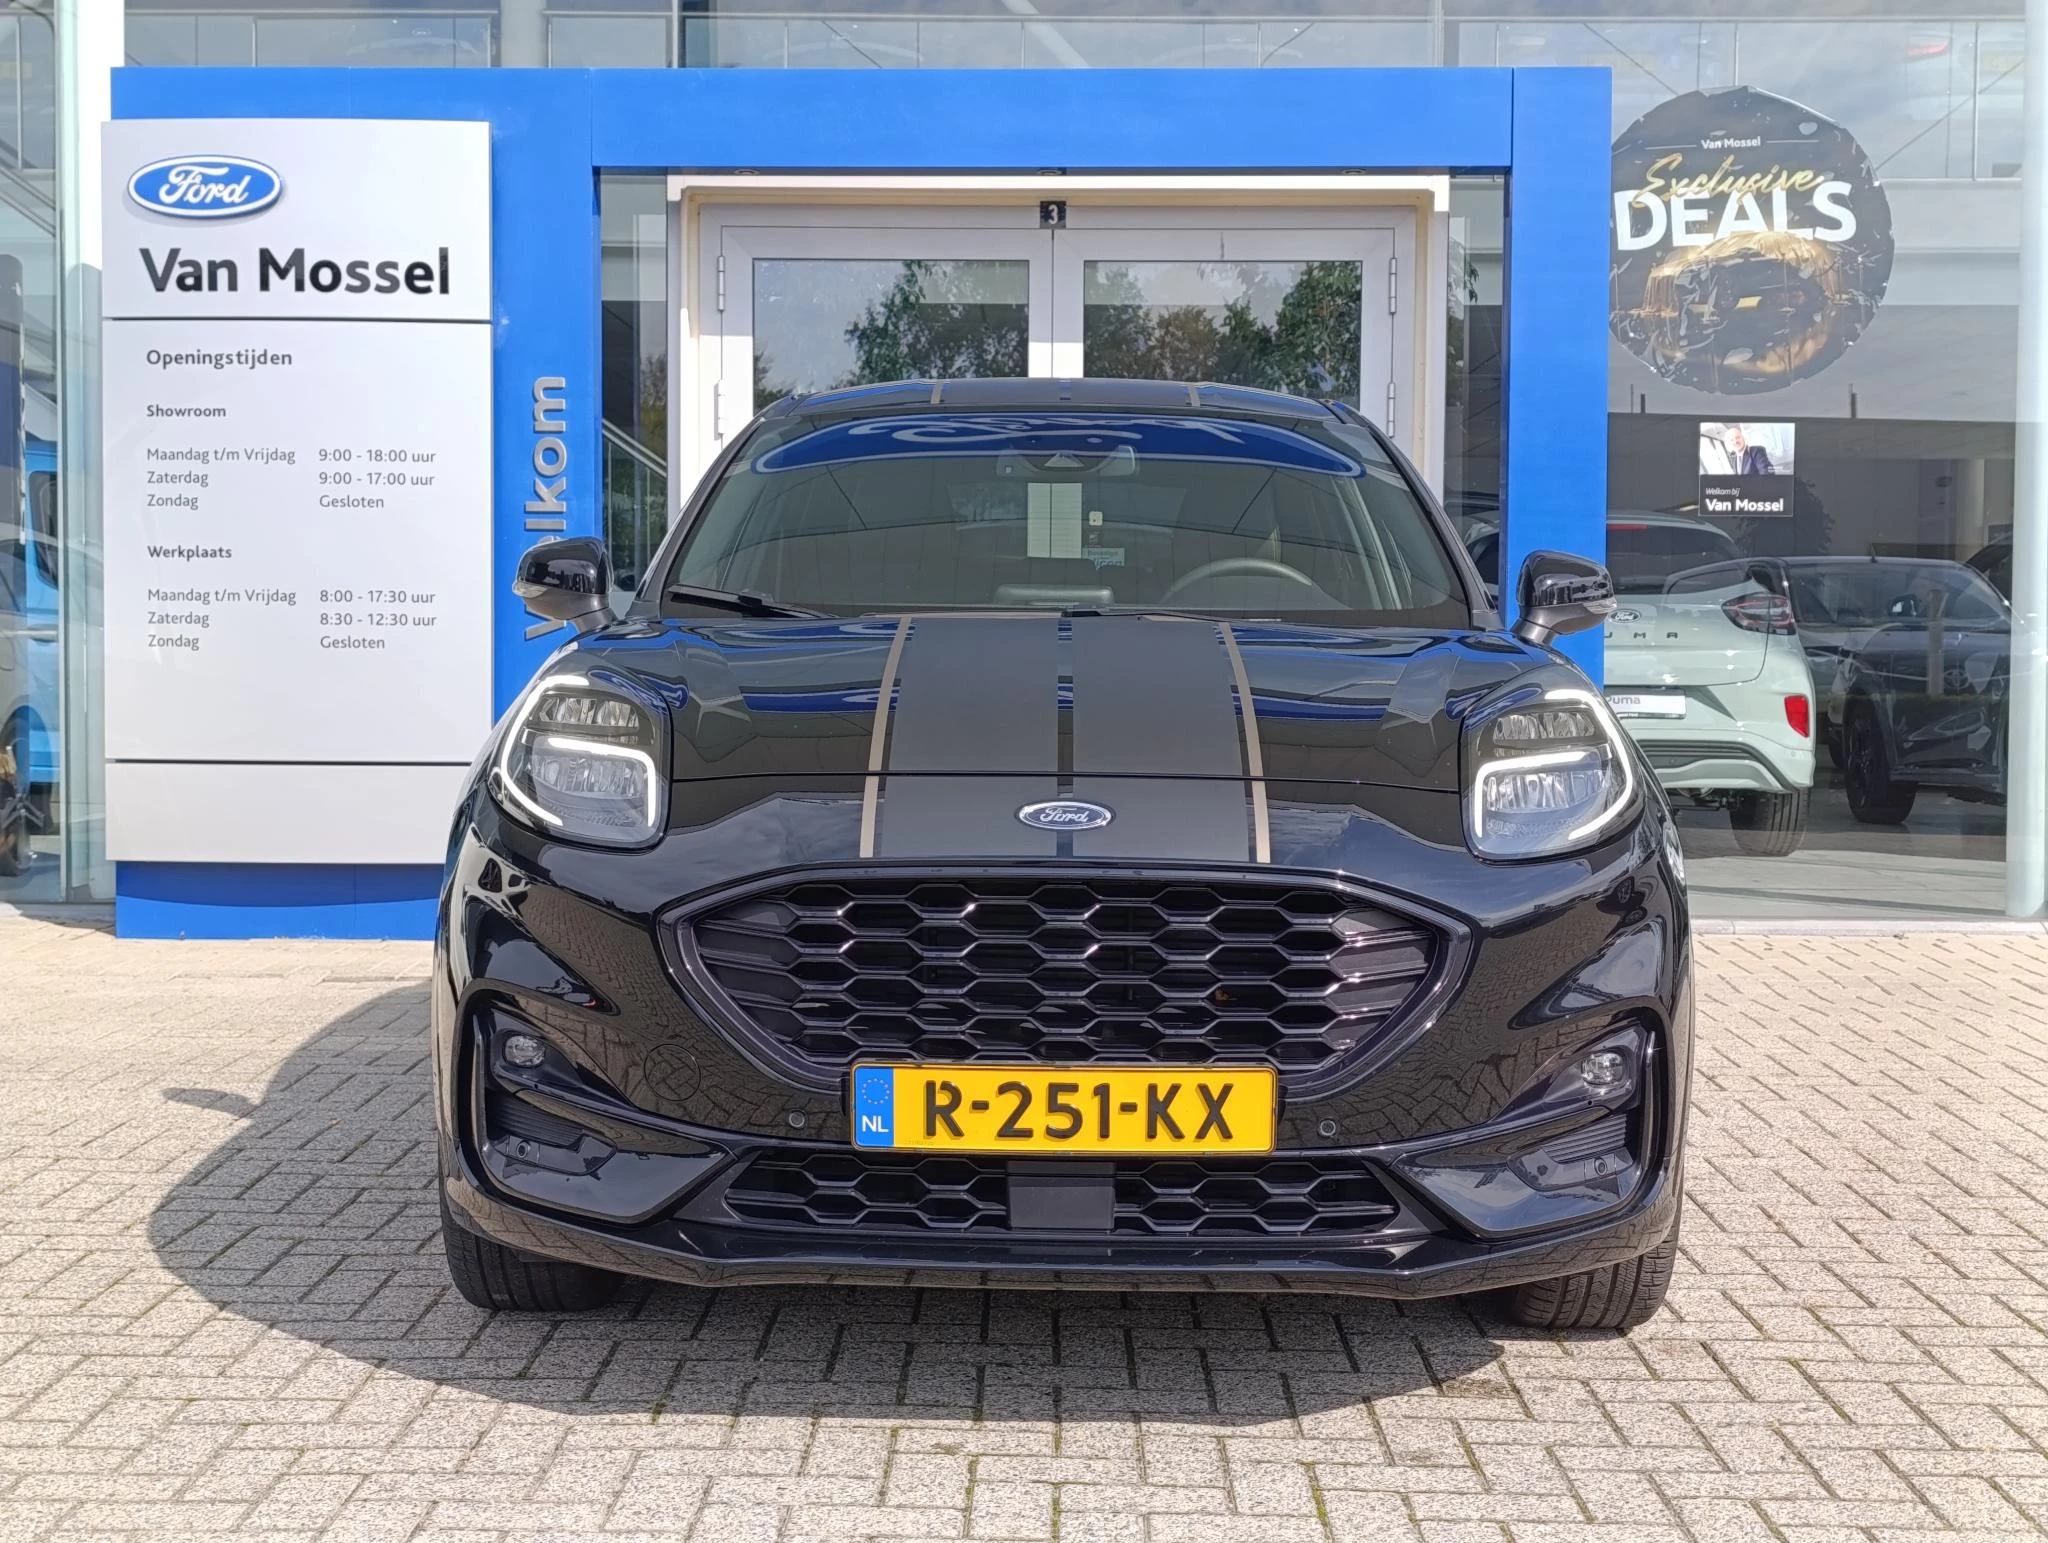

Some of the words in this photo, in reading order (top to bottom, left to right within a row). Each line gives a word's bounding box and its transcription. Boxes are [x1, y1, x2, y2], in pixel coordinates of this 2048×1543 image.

[1701, 138, 1722, 149] Van
[1723, 136, 1761, 148] Mossel
[158, 165, 252, 205] Ford
[1631, 153, 1824, 208] Exclusive
[1048, 204, 1058, 225] 3
[1614, 180, 1857, 250] DEALS
[138, 247, 239, 293] Van
[258, 246, 450, 295] Mossel
[146, 348, 293, 371] Openingstijden
[146, 403, 227, 418] Showroom
[147, 447, 210, 465] Maandag
[213, 447, 240, 461] t/m
[243, 447, 296, 465] Vrijdag
[318, 448, 352, 462] 9:00
[366, 448, 408, 463] 18:00
[411, 452, 437, 463] uur
[147, 470, 209, 488] Zaterdag
[318, 471, 353, 485] 9:00
[366, 471, 407, 486] 17:00
[410, 475, 436, 486] uur
[1705, 487, 1731, 495] Welkom
[147, 493, 199, 511] Zondag
[319, 494, 385, 509] Gesloten
[524, 376, 567, 641] lkom
[1705, 498, 1732, 511] Van
[1735, 497, 1784, 511] Mossel
[147, 544, 232, 562] Werkplaats
[147, 587, 211, 606] Maandag
[214, 588, 241, 602] t/m
[244, 588, 297, 607] Vrijdag
[319, 589, 353, 603] 8:00
[367, 589, 407, 604] 17:30
[411, 593, 437, 604] uur
[147, 611, 210, 629] Zaterdag
[319, 612, 353, 626] 8:30
[367, 612, 408, 627] 12:30
[412, 616, 438, 627] uur
[148, 633, 200, 652] Zondag
[319, 635, 386, 650] Gesloten
[1039, 806, 1090, 823] Ford
[923, 1080, 1234, 1140] R-251-KX
[862, 1115, 889, 1133] NL
